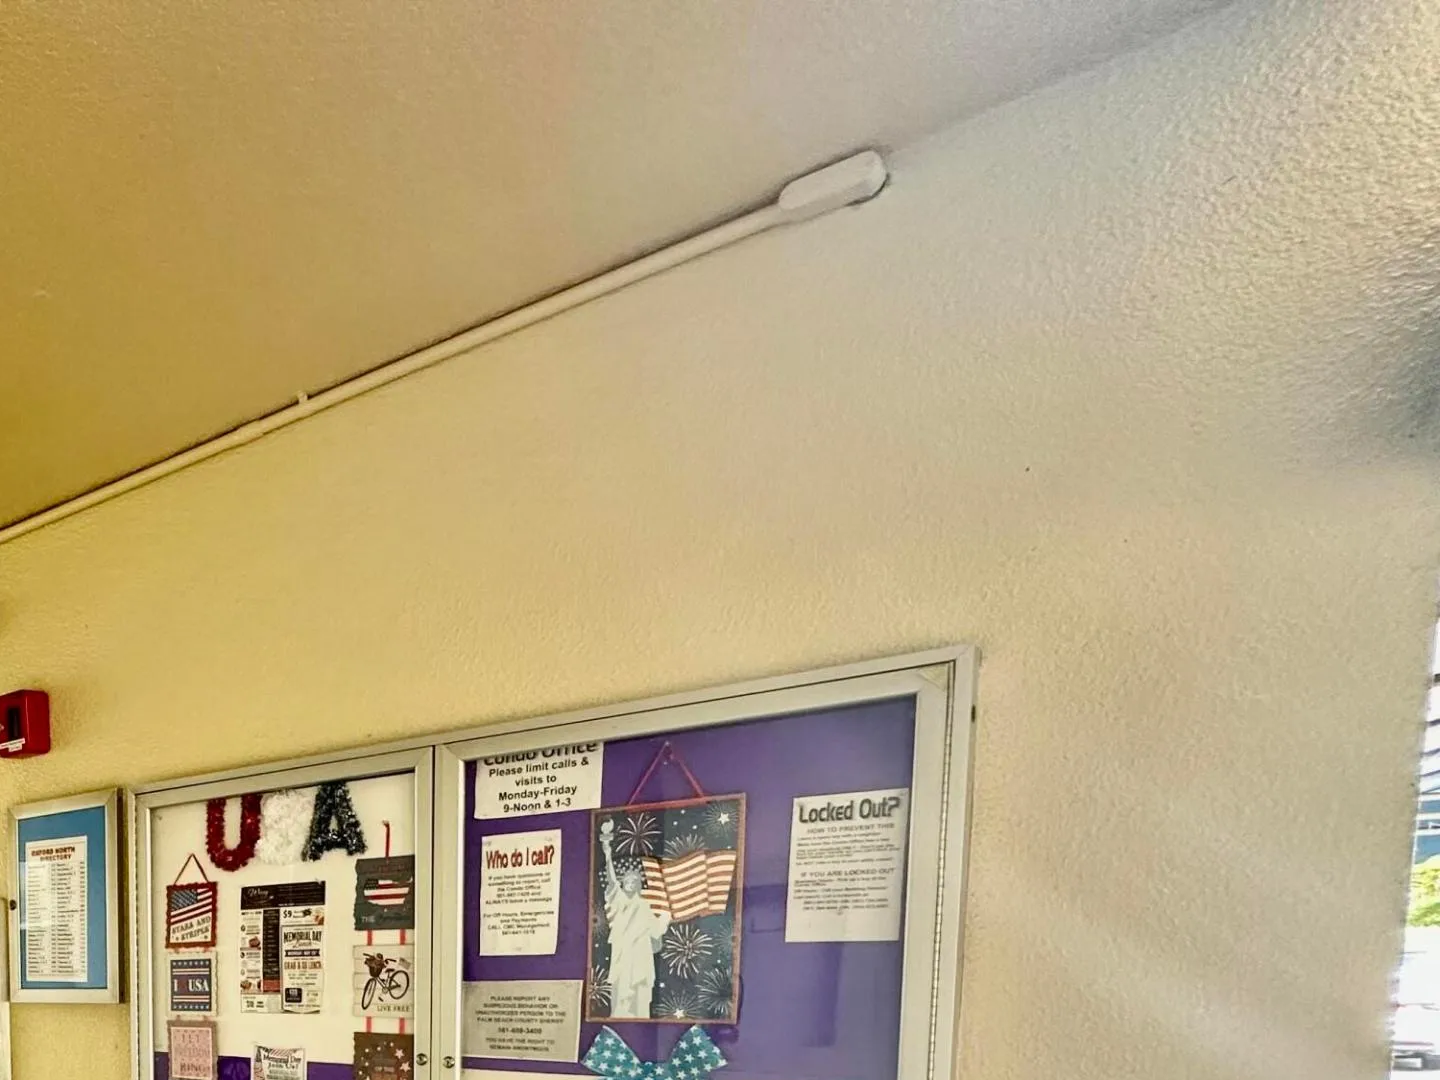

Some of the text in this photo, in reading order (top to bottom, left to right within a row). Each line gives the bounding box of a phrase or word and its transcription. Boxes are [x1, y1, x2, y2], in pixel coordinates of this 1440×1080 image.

[489, 757, 589, 778] Please limit calls &
[515, 775, 557, 787] visits to
[499, 786, 577, 801] Monday-Friday
[503, 798, 571, 813] 9-Noon & 1-3
[799, 797, 901, 823] Locked Out?
[839, 824, 875, 833] PREVENT
[486, 845, 555, 869] Who do I call?
[844, 868, 877, 876] LOCKED
[879, 867, 896, 875] OUT
[197, 916, 211, 927] AND
[283, 931, 311, 944] MEMORIAL
[173, 978, 210, 992] I USA
[376, 1004, 410, 1013] LIVE FREE
